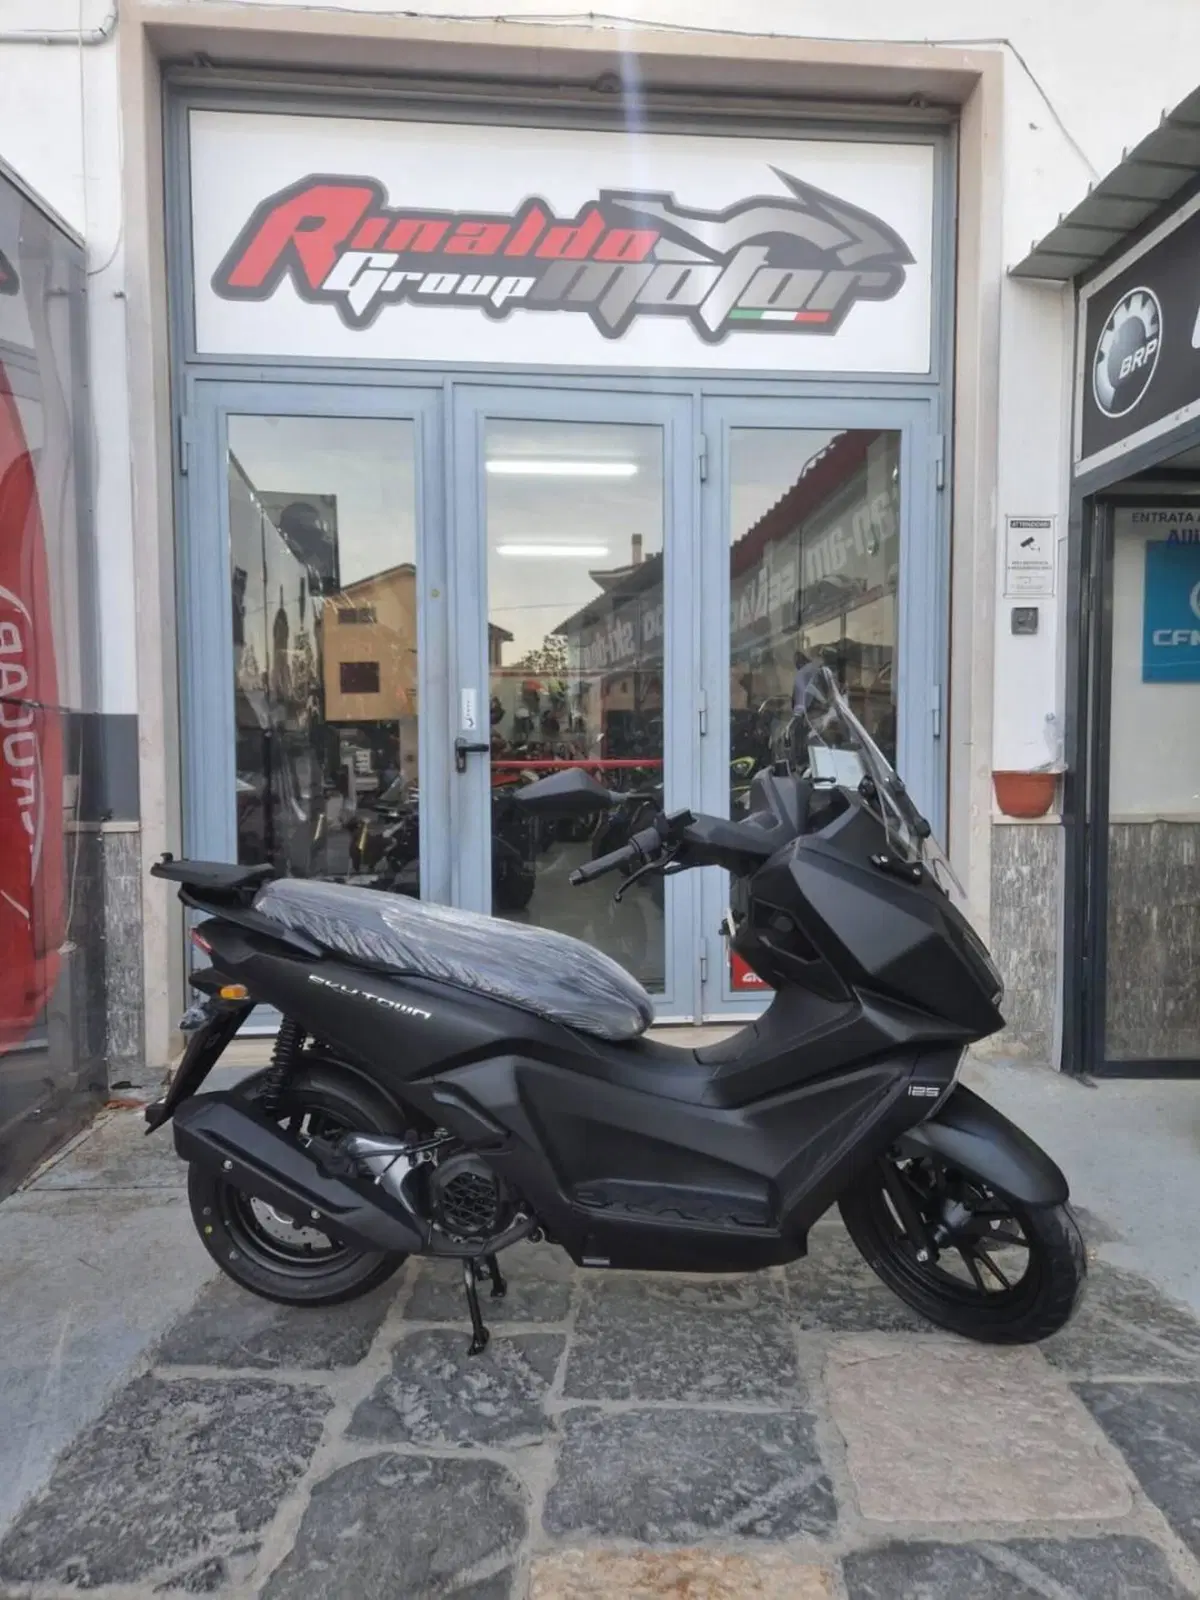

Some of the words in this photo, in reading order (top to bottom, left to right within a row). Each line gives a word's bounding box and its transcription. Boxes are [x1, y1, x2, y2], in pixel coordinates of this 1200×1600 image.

[227, 184, 661, 290] Rinaldo
[321, 251, 537, 317] Group
[1119, 338, 1159, 380] BRP
[1131, 511, 1194, 524] ENTRATA
[908, 1085, 940, 1097] 125
